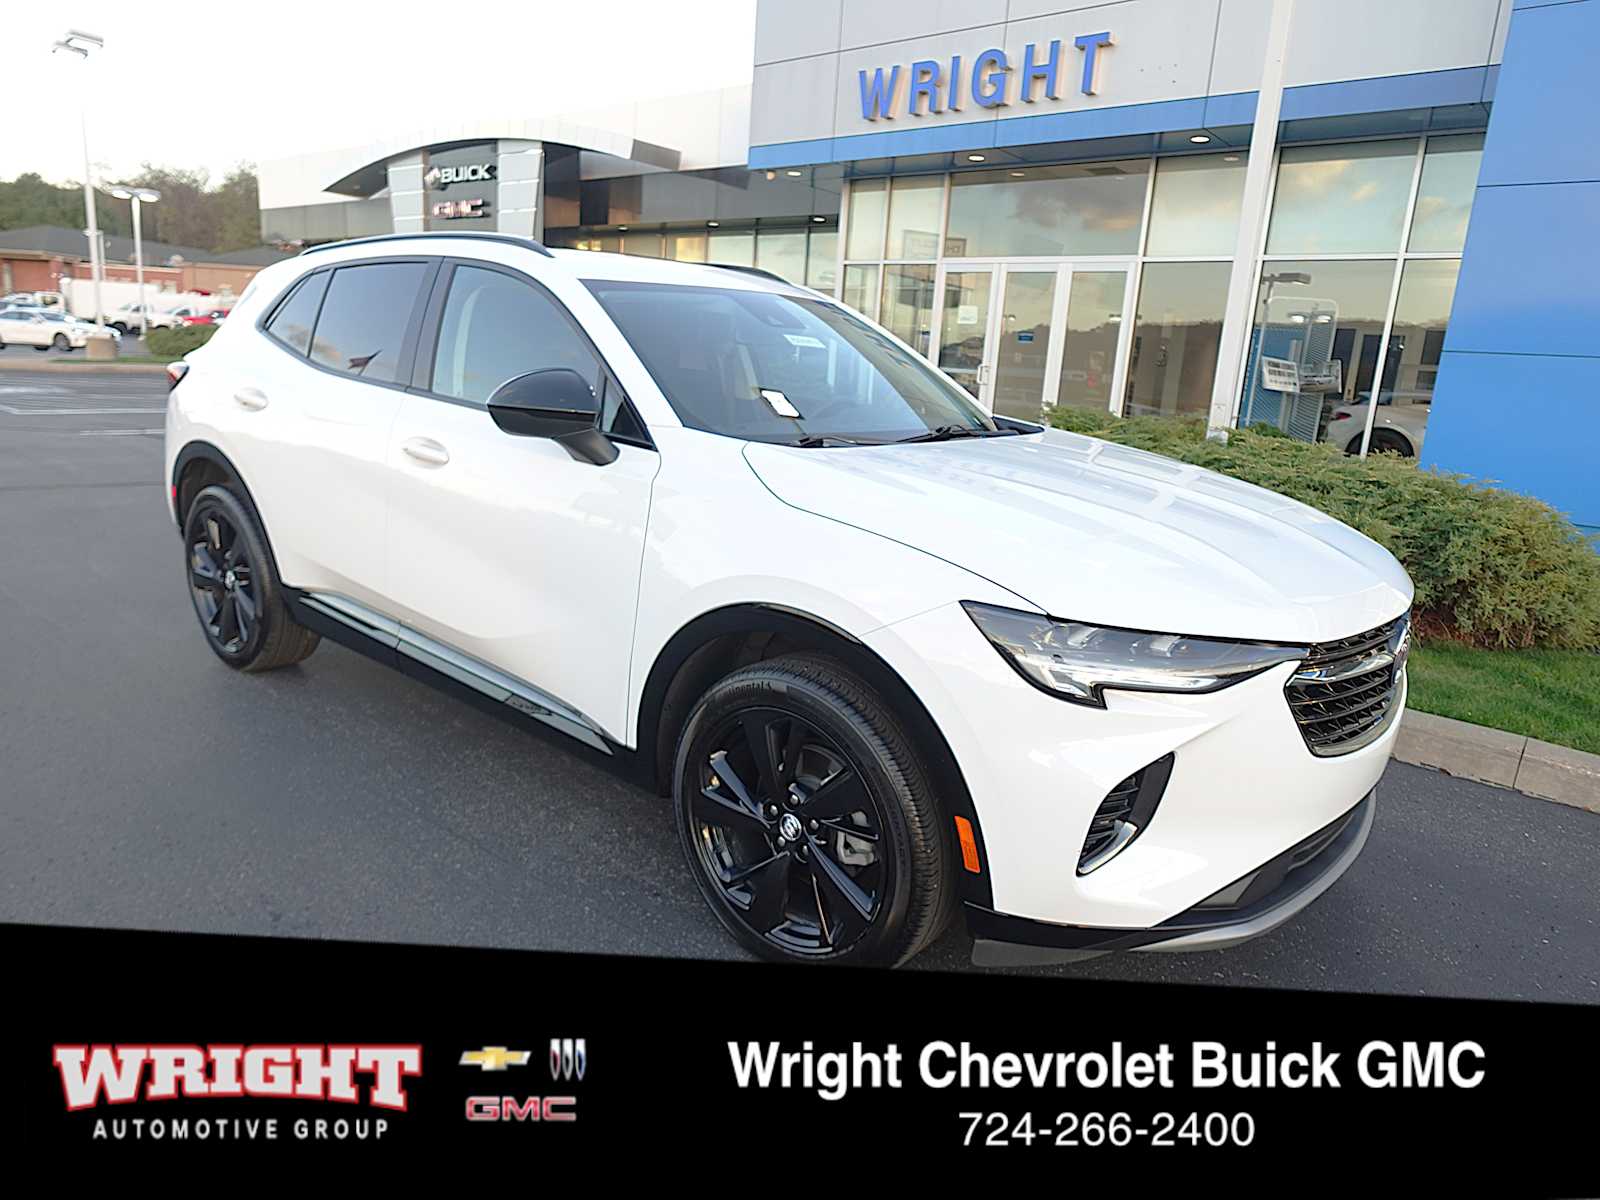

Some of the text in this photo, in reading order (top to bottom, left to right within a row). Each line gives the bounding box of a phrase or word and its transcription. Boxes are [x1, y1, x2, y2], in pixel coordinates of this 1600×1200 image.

[858, 31, 1114, 121] WRIGHT
[440, 163, 492, 183] BUICK
[432, 198, 484, 218] GMC
